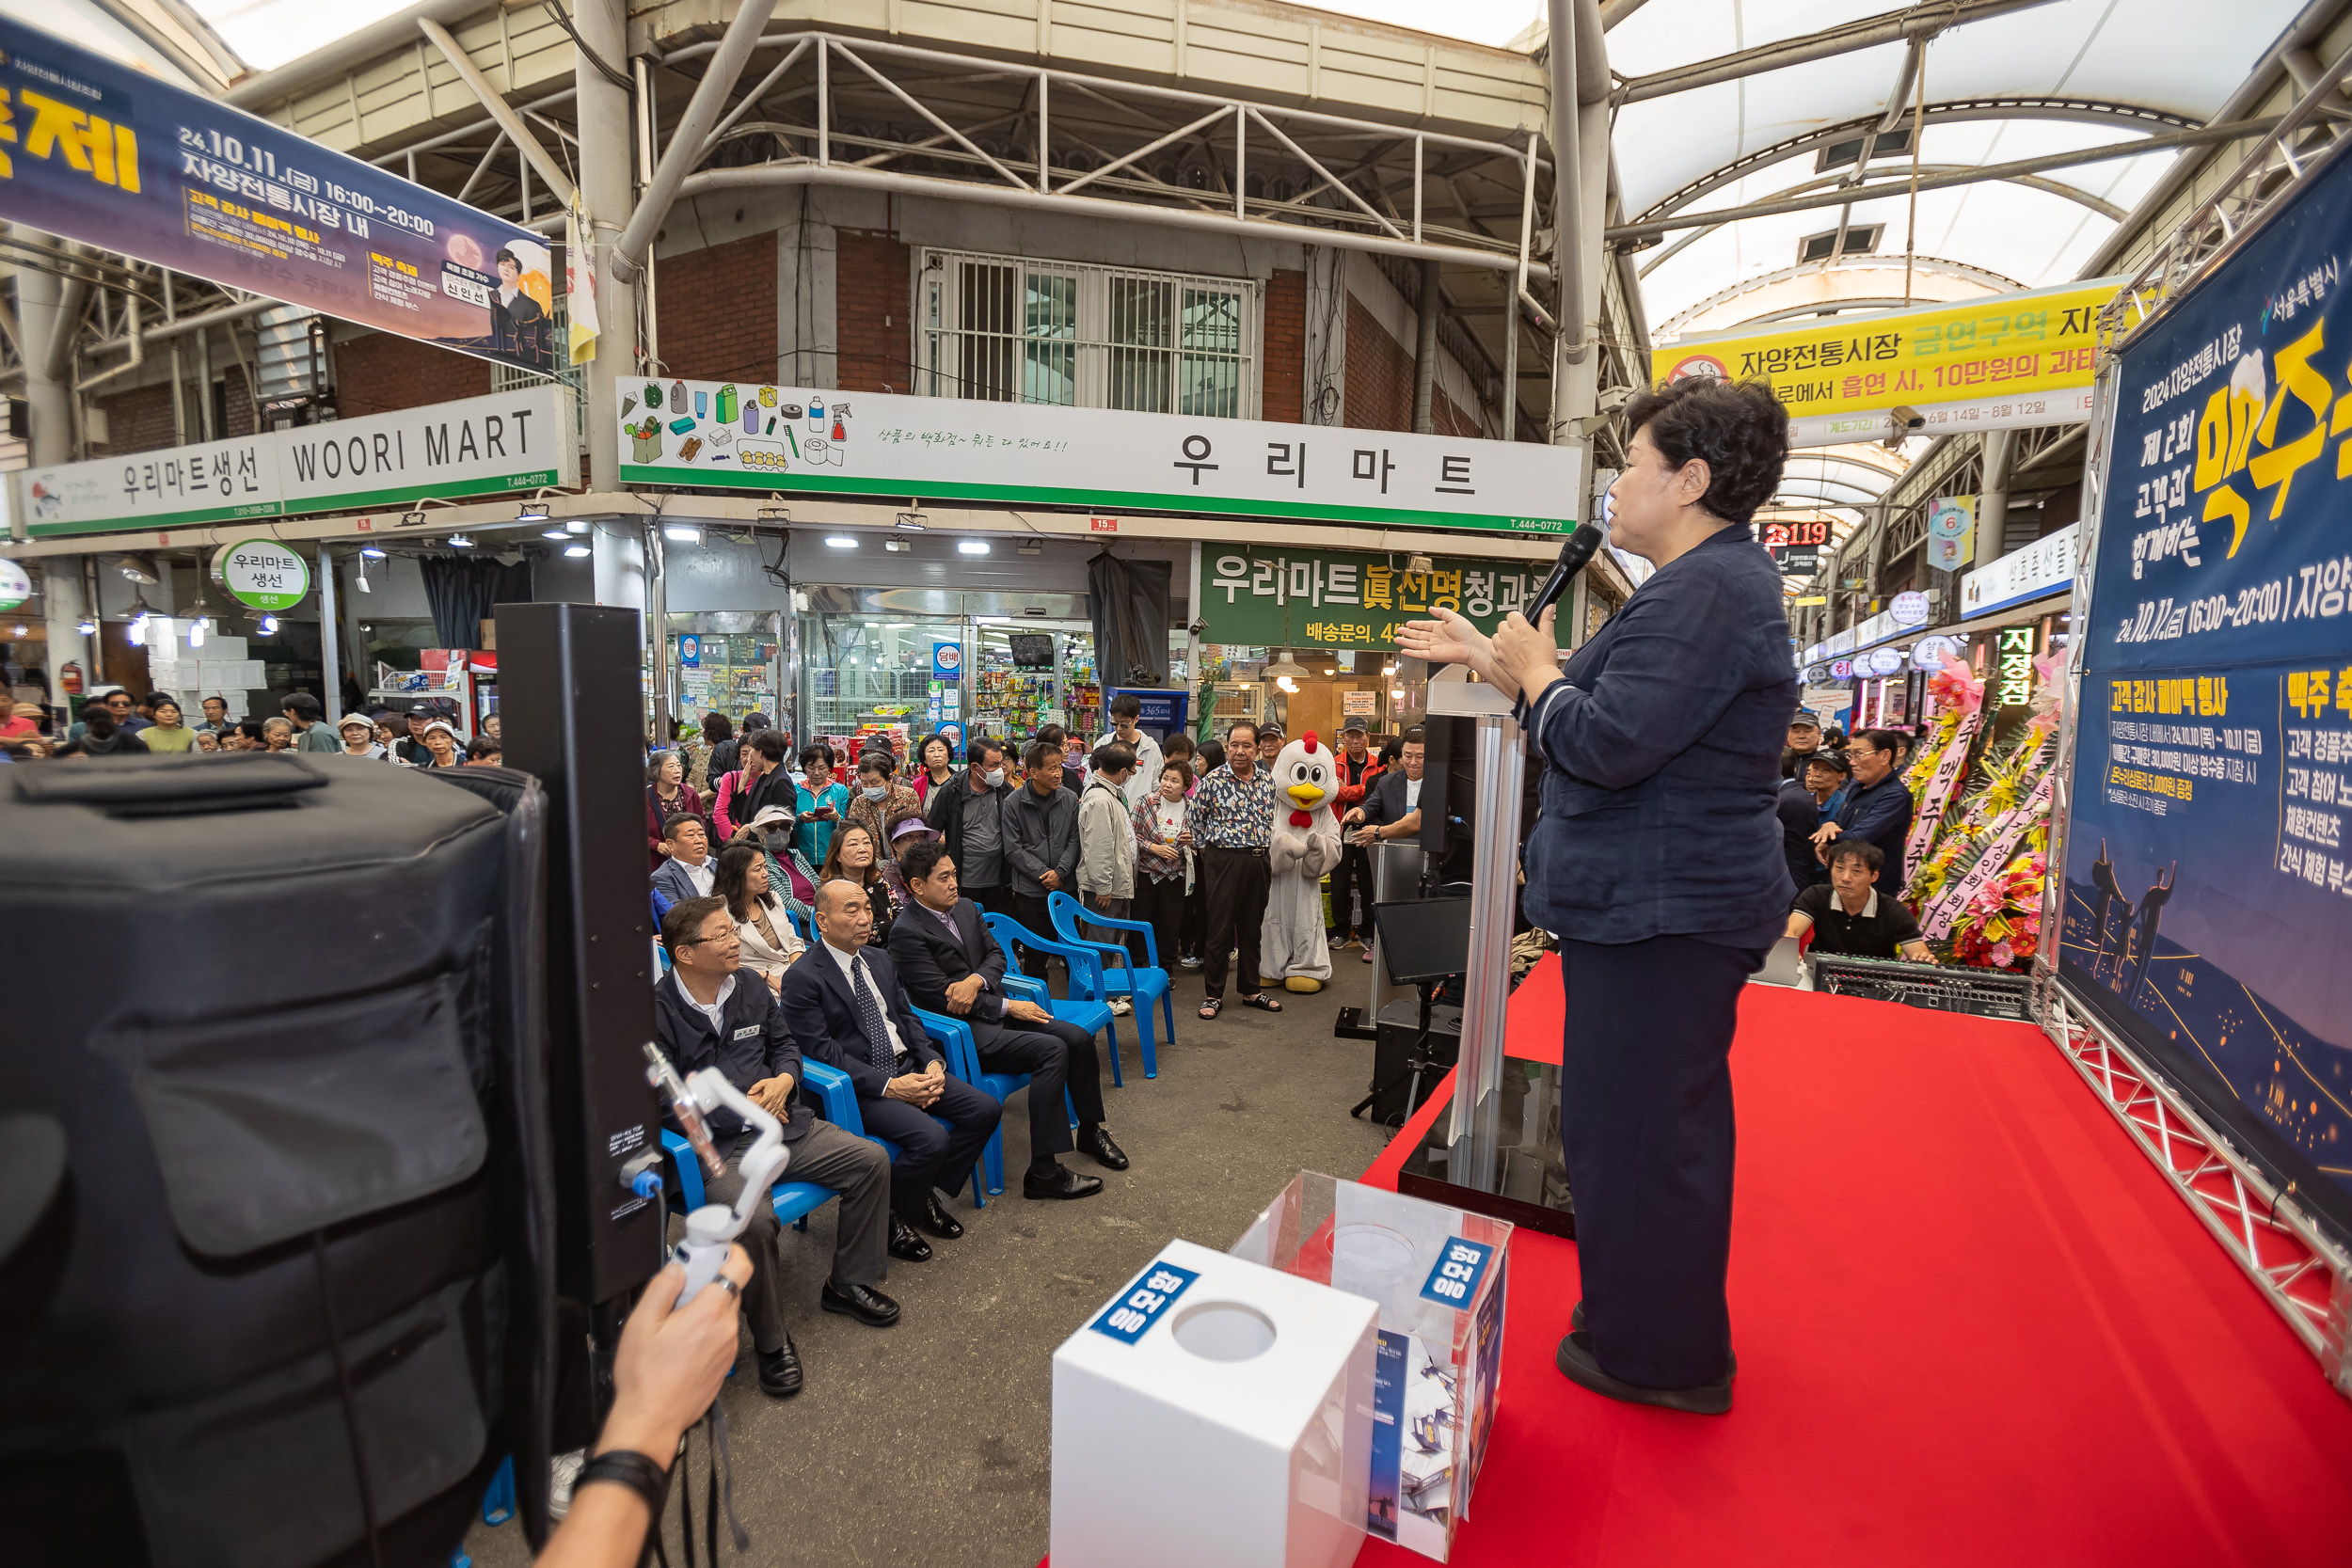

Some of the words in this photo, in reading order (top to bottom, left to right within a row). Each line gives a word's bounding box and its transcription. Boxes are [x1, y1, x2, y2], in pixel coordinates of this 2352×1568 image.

[0, 85, 141, 194] 제
[181, 151, 341, 229] 자양전통시장
[346, 212, 370, 240] 내
[325, 180, 435, 236] 16:00~20:00
[2272, 256, 2339, 323] 서울특별시
[1739, 333, 1904, 376] 자양전통시장
[1912, 310, 2049, 357] 금연구역
[1774, 384, 1834, 405] 로에서
[1841, 374, 1887, 400] 흡연
[1932, 353, 2040, 388] 10만원의
[878, 428, 916, 445] 상품의
[971, 434, 995, 448] 뭐든
[1001, 438, 1013, 447] 다
[1828, 417, 1874, 434] 계도기간
[1929, 410, 1948, 424] 6월
[2016, 401, 2047, 416] 12일
[293, 429, 405, 483] WOORI
[424, 408, 533, 467] MART
[506, 473, 548, 488] T.444-0772
[2135, 464, 2192, 524] 고객과
[1097, 519, 1108, 529] 15
[1509, 518, 1564, 532] T.444-0772
[1946, 516, 1957, 530] 6
[233, 554, 296, 570] 우리마트
[2132, 515, 2201, 580] 함께하는
[251, 573, 283, 589] 생선
[259, 594, 279, 605] 생선
[2187, 580, 2281, 634] 16:00~20:00
[939, 652, 959, 662] 담배
[2112, 680, 2132, 712] 고객
[2133, 679, 2155, 713] 감사
[2157, 678, 2196, 716] 페이백
[2198, 675, 2229, 716] 행사
[2287, 671, 2330, 719] 맥주
[2171, 726, 2200, 746] 24.10.10
[2222, 729, 2243, 750] 10.11
[2244, 729, 2263, 754] (금)
[2287, 729, 2312, 759] 고객
[2151, 748, 2182, 772] 30,000원
[2183, 752, 2199, 775] 이상
[2200, 755, 2225, 780] 영수증
[2226, 758, 2245, 783] 지참
[2246, 761, 2257, 784] 시
[2286, 768, 2310, 800] 고객
[2311, 768, 2337, 805] 참여
[2176, 779, 2193, 801] 증정
[2284, 803, 2342, 847] 체험컨텐츠
[2280, 842, 2303, 879] 간식
[2303, 846, 2326, 887] 체험
[1432, 1244, 1482, 1300] 응모함
[1107, 1270, 1184, 1334] 응모함
